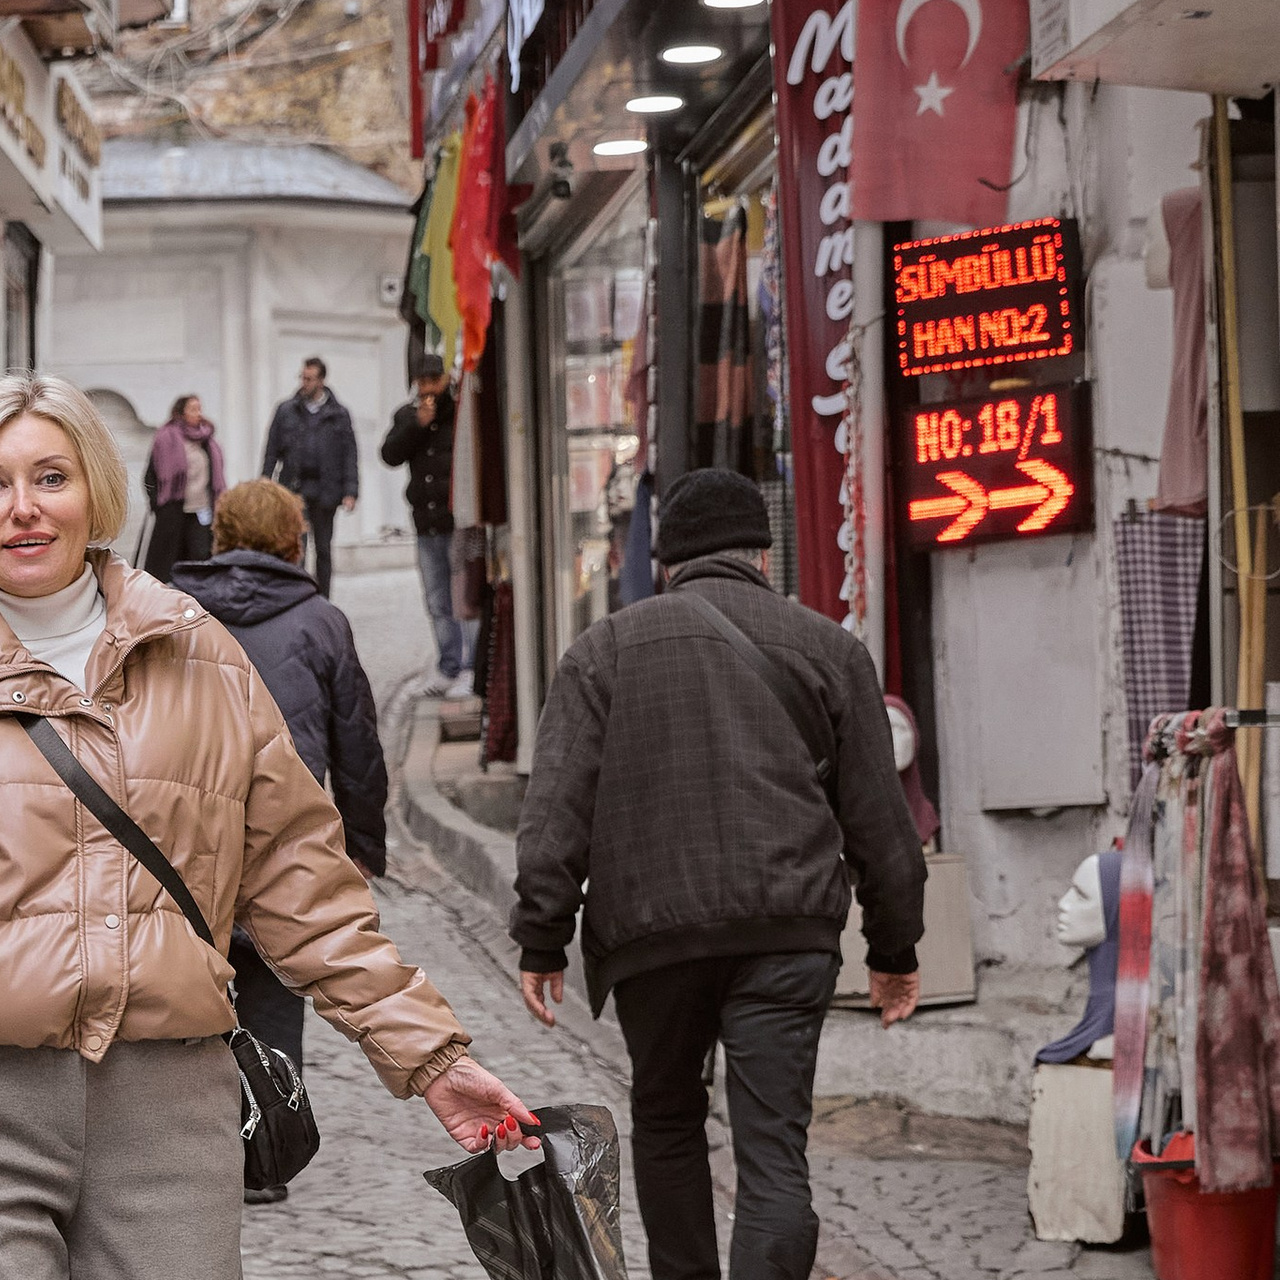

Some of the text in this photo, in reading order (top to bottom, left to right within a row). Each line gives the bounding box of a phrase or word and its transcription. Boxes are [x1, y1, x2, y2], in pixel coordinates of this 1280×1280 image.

[899, 234, 1057, 303] SÜMBÜLLÜ
[913, 303, 1051, 359] HAN NO:2
[915, 393, 1063, 464] NO: 18/1
